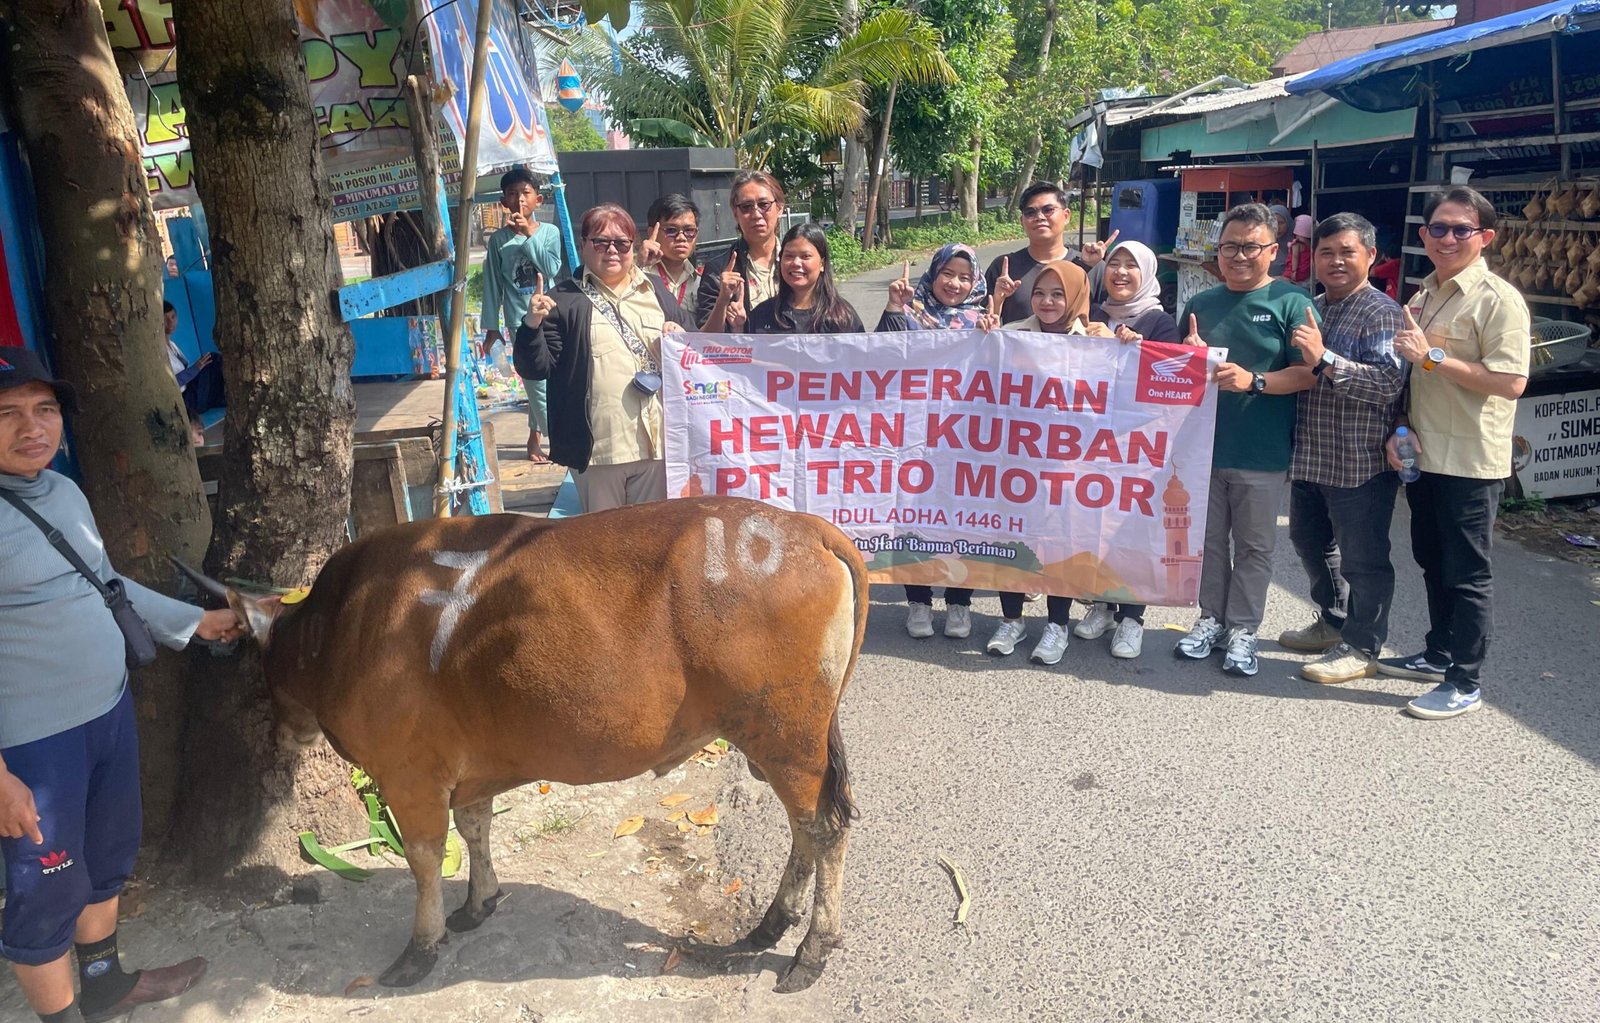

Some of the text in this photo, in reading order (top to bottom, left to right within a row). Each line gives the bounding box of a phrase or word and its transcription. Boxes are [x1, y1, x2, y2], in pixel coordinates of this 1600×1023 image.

[346, 175, 378, 190] POSKO
[345, 184, 398, 204] MINUMAN
[332, 204, 360, 219] ASIH
[365, 199, 392, 212] ATAS
[702, 346, 721, 354] TRIO
[722, 346, 753, 355] MOTOR
[1150, 375, 1193, 385] HONDA
[766, 369, 1108, 415] PENYERAHAN
[1148, 388, 1164, 398] One
[710, 412, 1168, 469] HEWAN KURBAN
[1534, 470, 1560, 482] BADAN
[716, 459, 1155, 517] PT. TRIO MOTOR
[832, 508, 1024, 533] IDUL ADHA 1446 H
[704, 514, 786, 584] 10
[868, 533, 903, 553] Hati
[906, 537, 952, 553] Banua
[954, 539, 1017, 560] Beriman
[42, 858, 74, 875] STYLE
